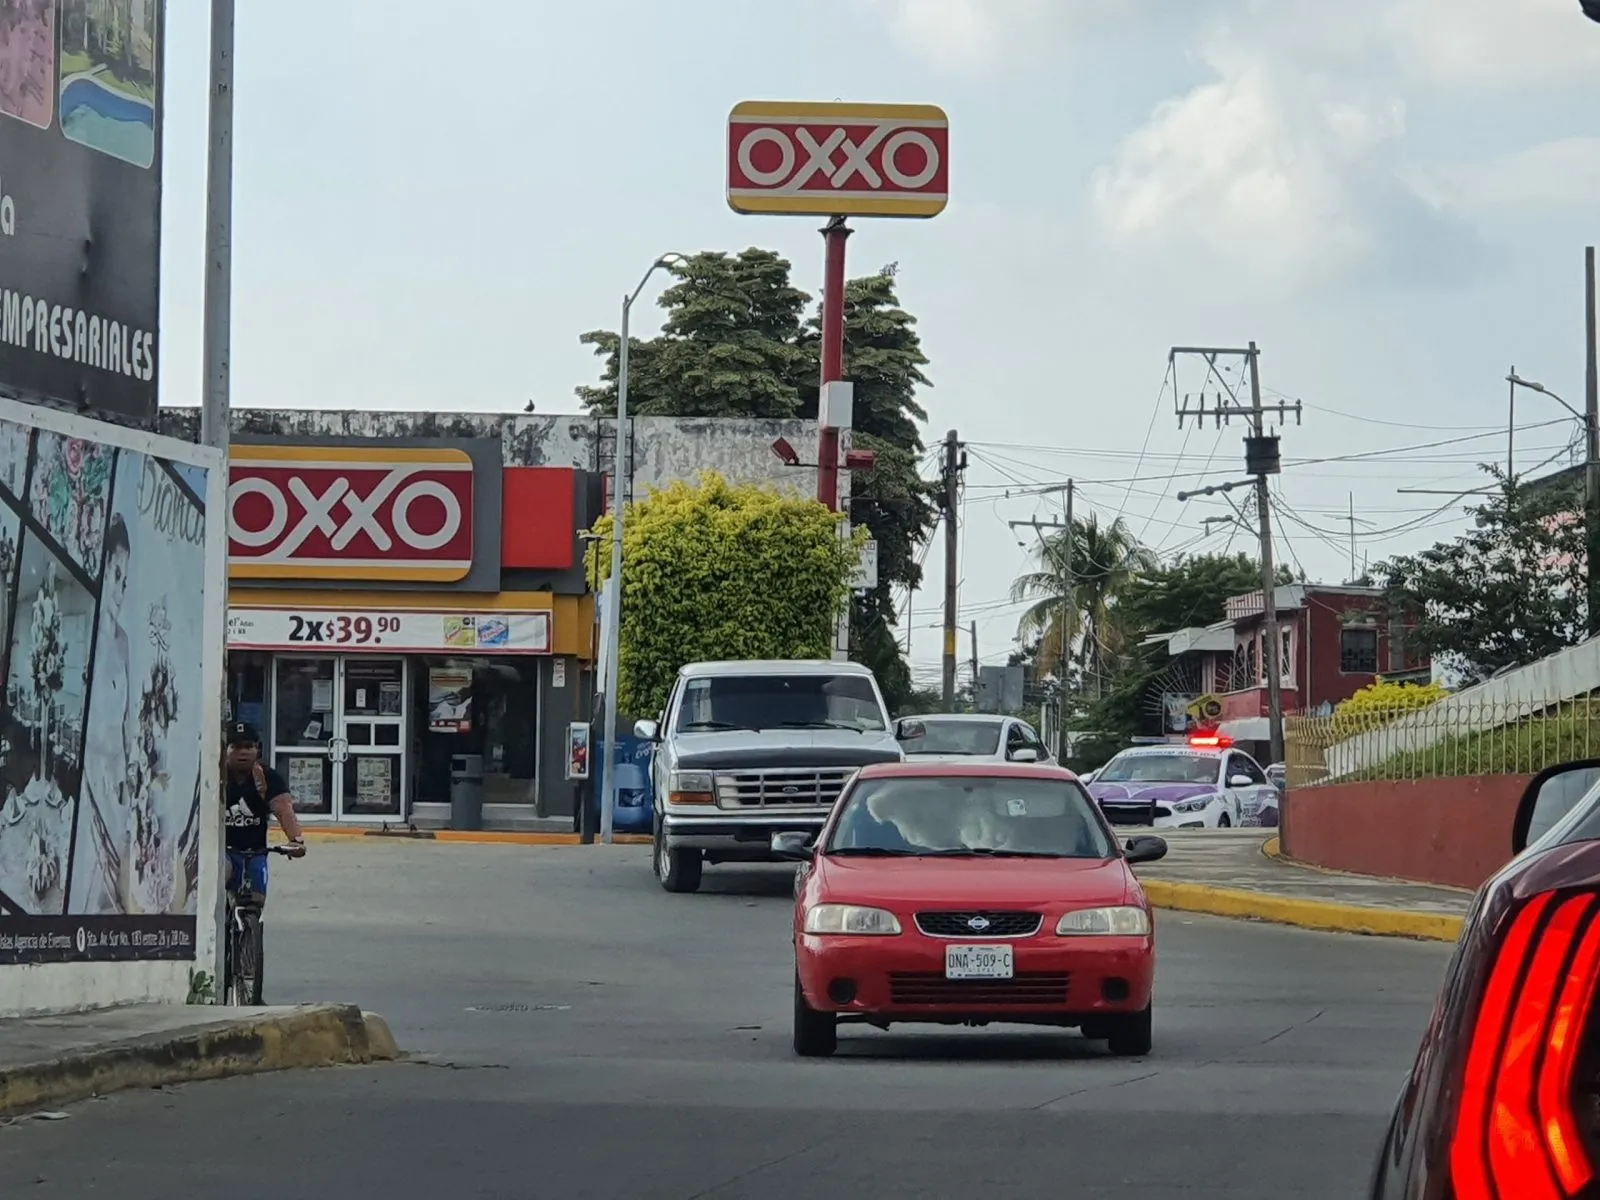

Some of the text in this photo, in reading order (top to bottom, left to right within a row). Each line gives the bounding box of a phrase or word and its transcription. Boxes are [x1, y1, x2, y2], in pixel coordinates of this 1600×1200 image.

[737, 124, 940, 194] OXXO
[0, 194, 15, 236] a
[0, 287, 153, 381] MPRESARIALES
[227, 475, 462, 558] OXXO
